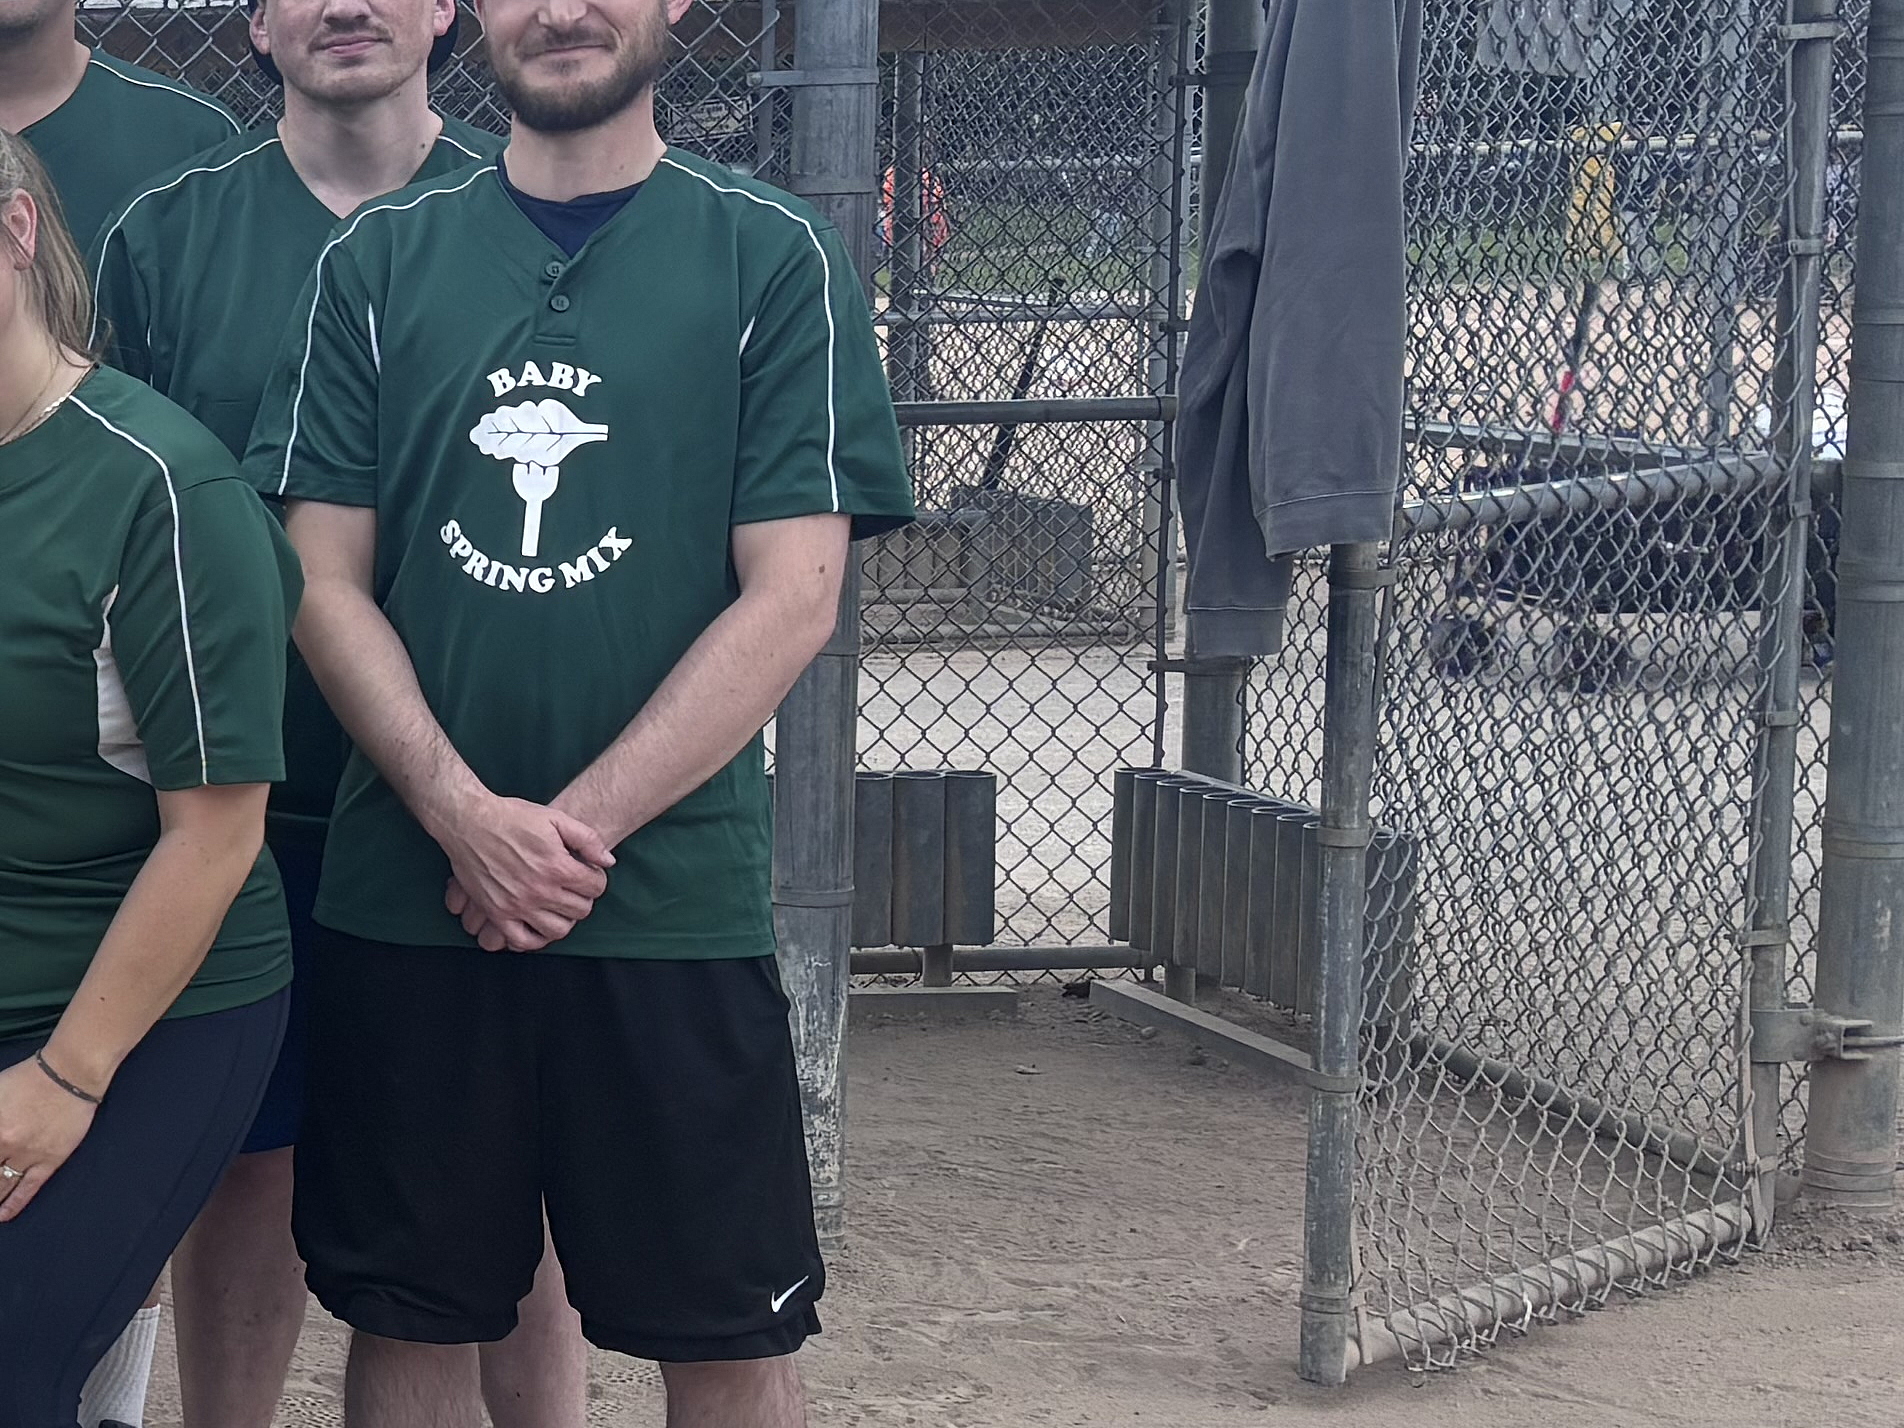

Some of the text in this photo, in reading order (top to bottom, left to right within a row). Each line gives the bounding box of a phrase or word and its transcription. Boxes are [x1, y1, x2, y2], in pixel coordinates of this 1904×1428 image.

[486, 361, 602, 397] BABY
[440, 520, 632, 593] SPRING MIX
